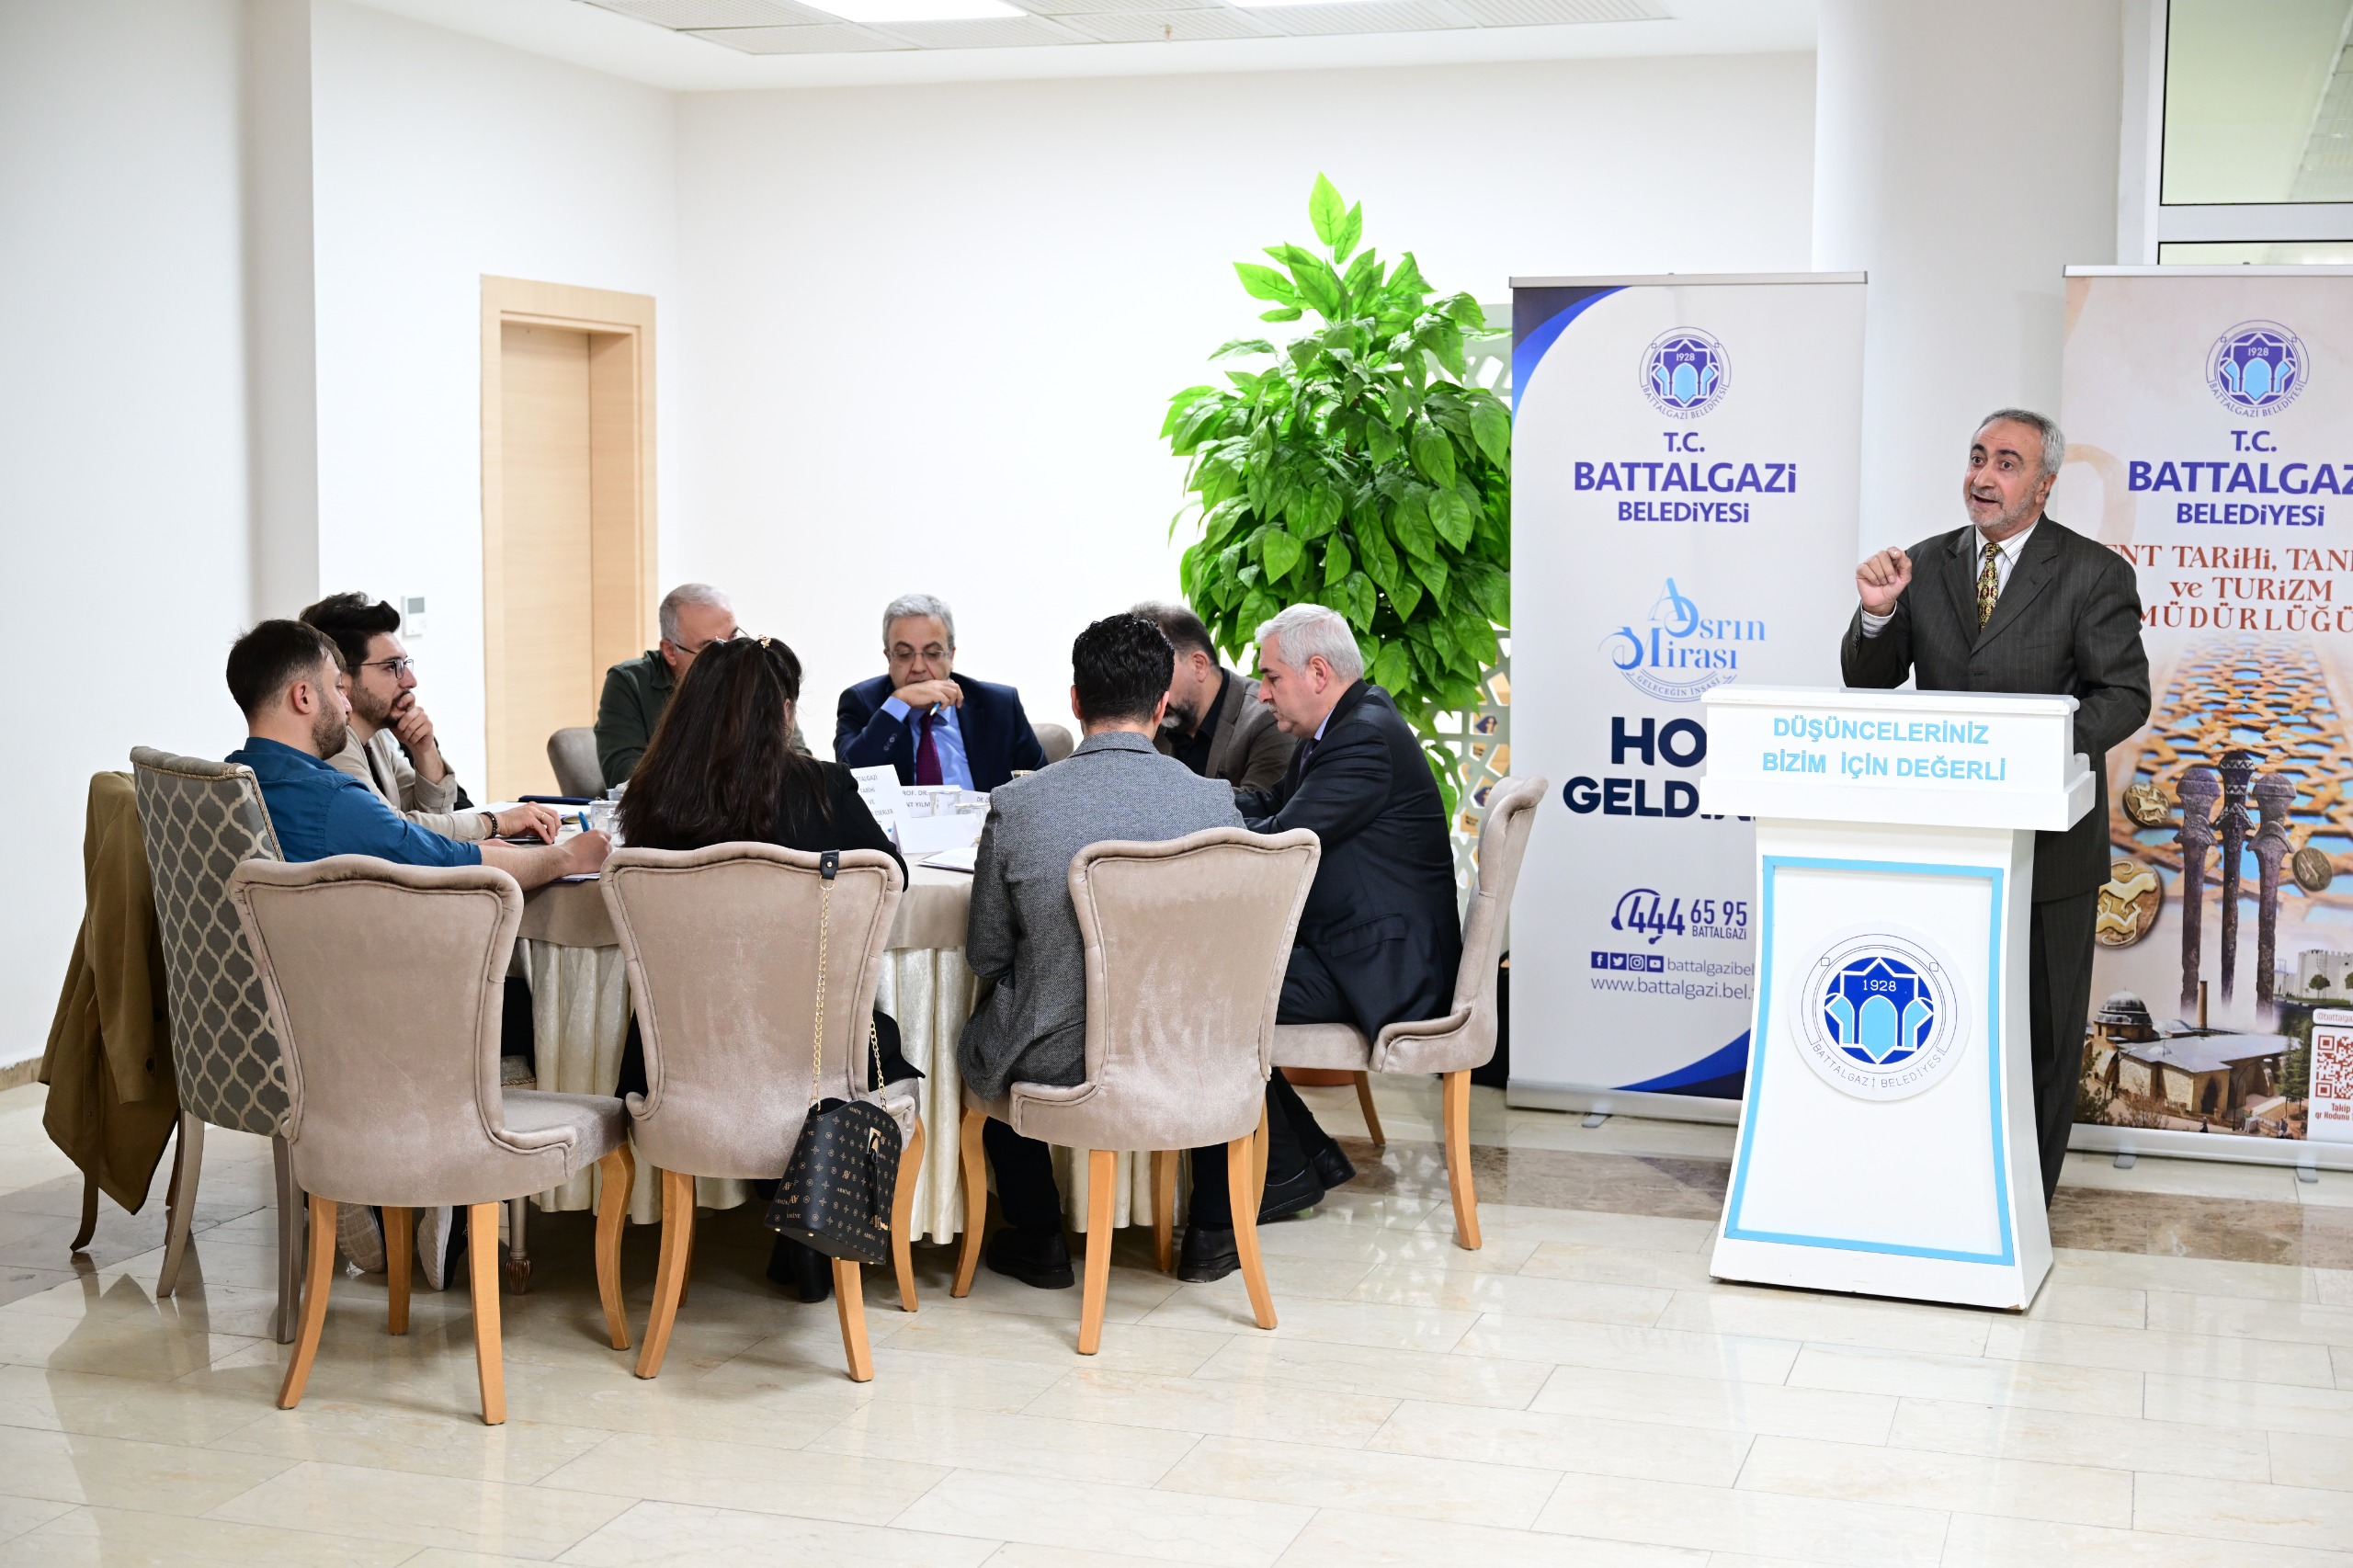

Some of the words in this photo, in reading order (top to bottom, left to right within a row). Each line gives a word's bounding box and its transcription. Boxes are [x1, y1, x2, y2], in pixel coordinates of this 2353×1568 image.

[1676, 353, 1696, 361] 1928
[2248, 347, 2268, 357] 1928
[1664, 432, 1705, 452] T.C.
[2231, 430, 2278, 452] T.C.
[2128, 460, 2353, 495] BATTALGAZ
[2105, 544, 2162, 567] NT
[2169, 581, 2202, 597] ve
[1636, 676, 1688, 696] GELECEĞİN
[1773, 714, 1989, 744] DÜŞÜNCELERİNİZ
[1611, 716, 1707, 767] HO
[1763, 748, 1826, 773] BİZİM
[1841, 751, 1888, 778] İÇİN
[1896, 755, 2006, 780] DEĞERLİ
[1563, 776, 1756, 821] GELD
[1627, 895, 1685, 936] 444
[1690, 899, 1715, 925] 65
[1722, 901, 1747, 926] 95
[1591, 976, 1754, 1000] www.battalgazi.bel.
[1863, 980, 1897, 992] 1928
[2317, 1012, 2353, 1023] @battalga
[1813, 1043, 1876, 1087] BATTALGAZİ
[2331, 1103, 2351, 1113] Takip
